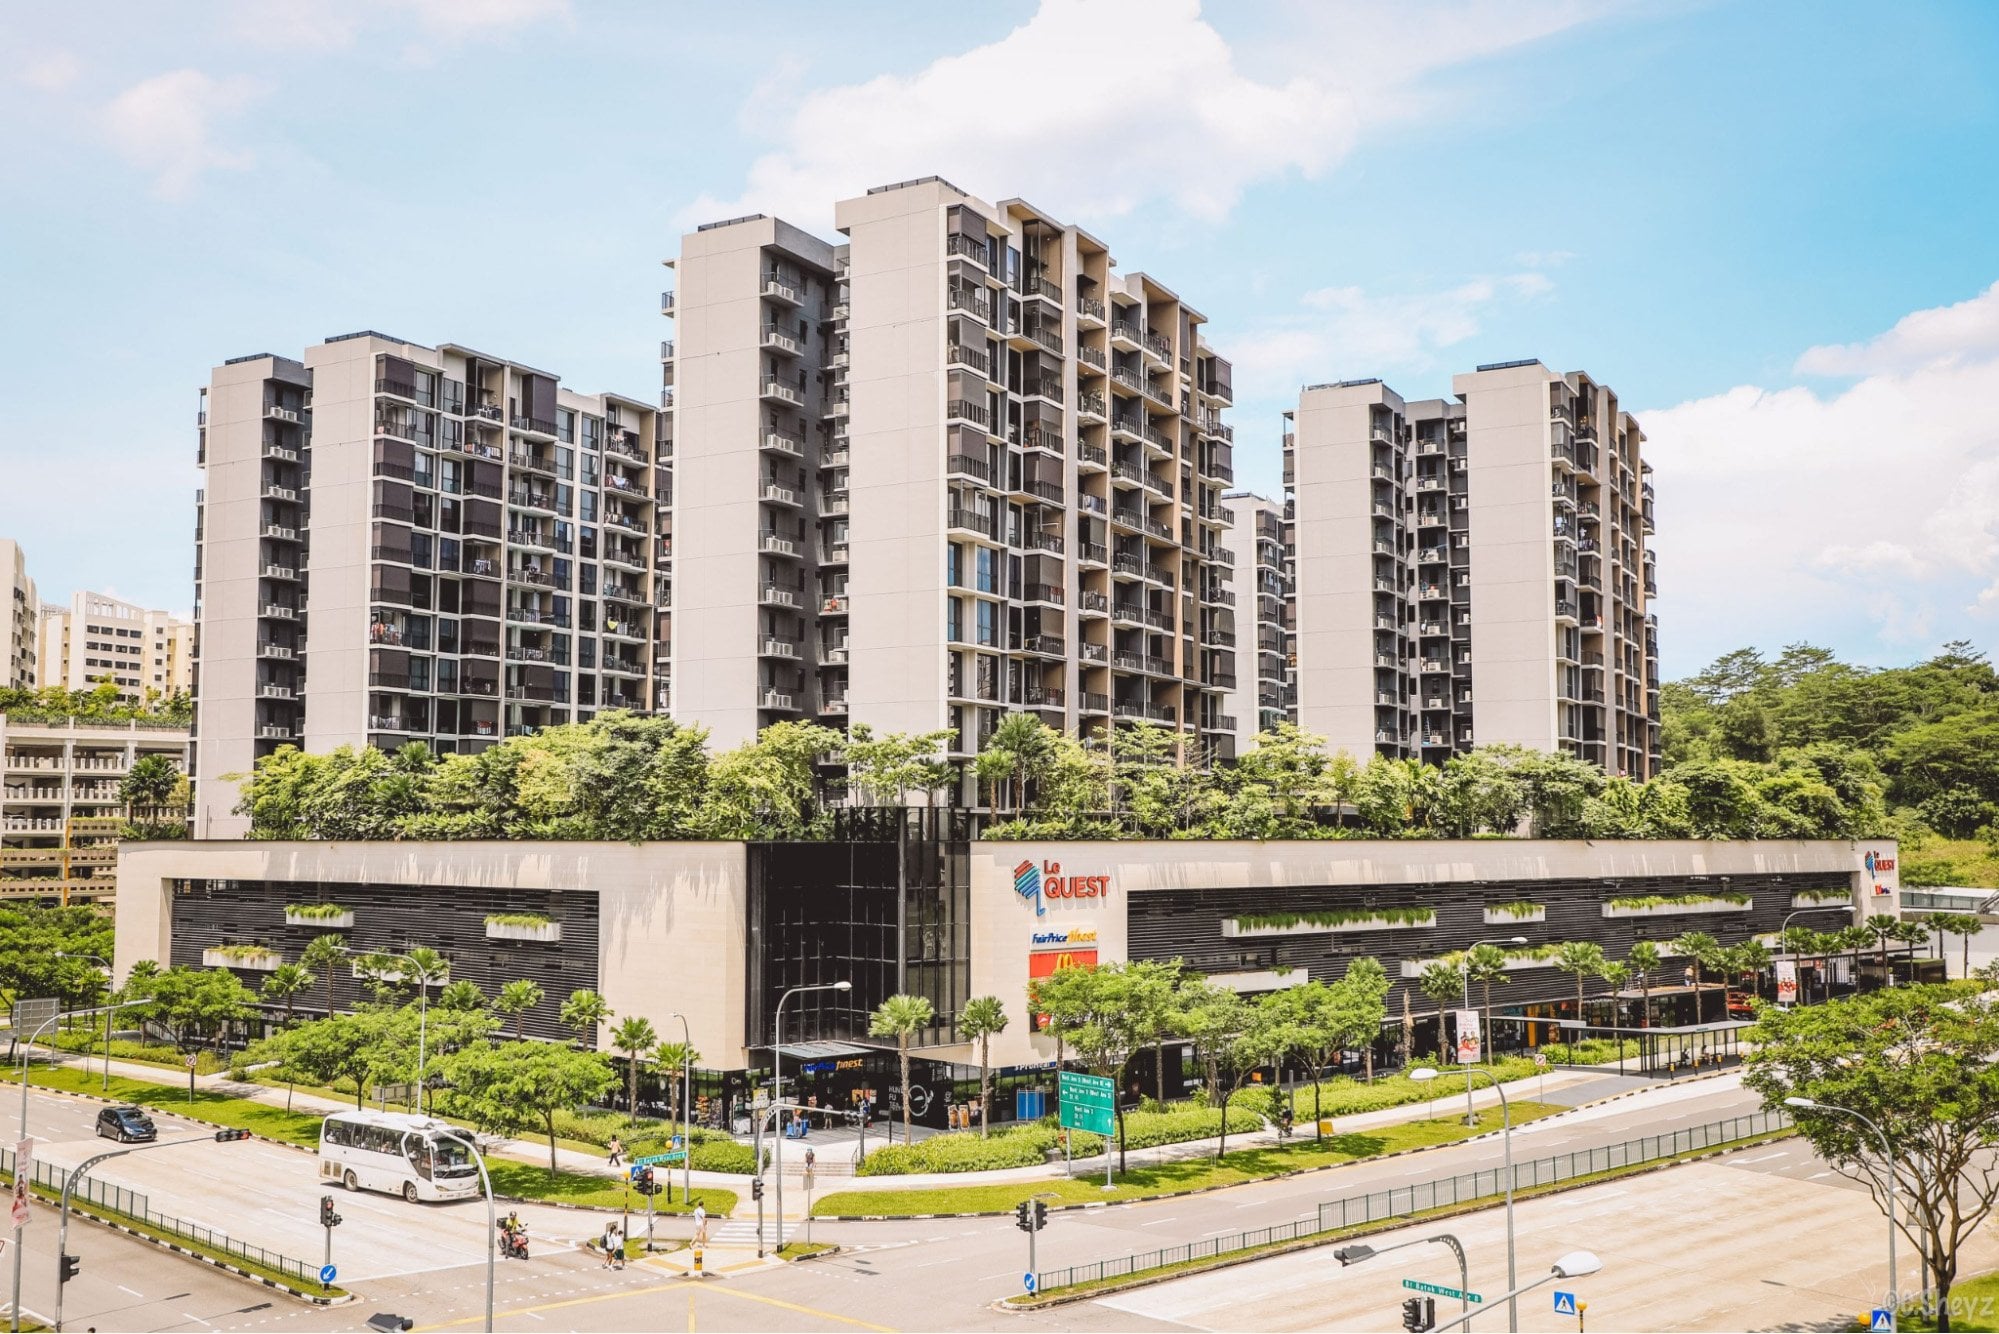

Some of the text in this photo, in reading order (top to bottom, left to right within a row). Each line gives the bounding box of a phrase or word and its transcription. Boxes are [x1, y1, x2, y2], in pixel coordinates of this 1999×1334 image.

[1043, 860, 1060, 874] Le
[1044, 876, 1110, 898] QUEST
[835, 1059, 863, 1071] finest
[1415, 1282, 1435, 1293] Batok
[1438, 1288, 1456, 1297] West
[1458, 1291, 1471, 1300] Ae
